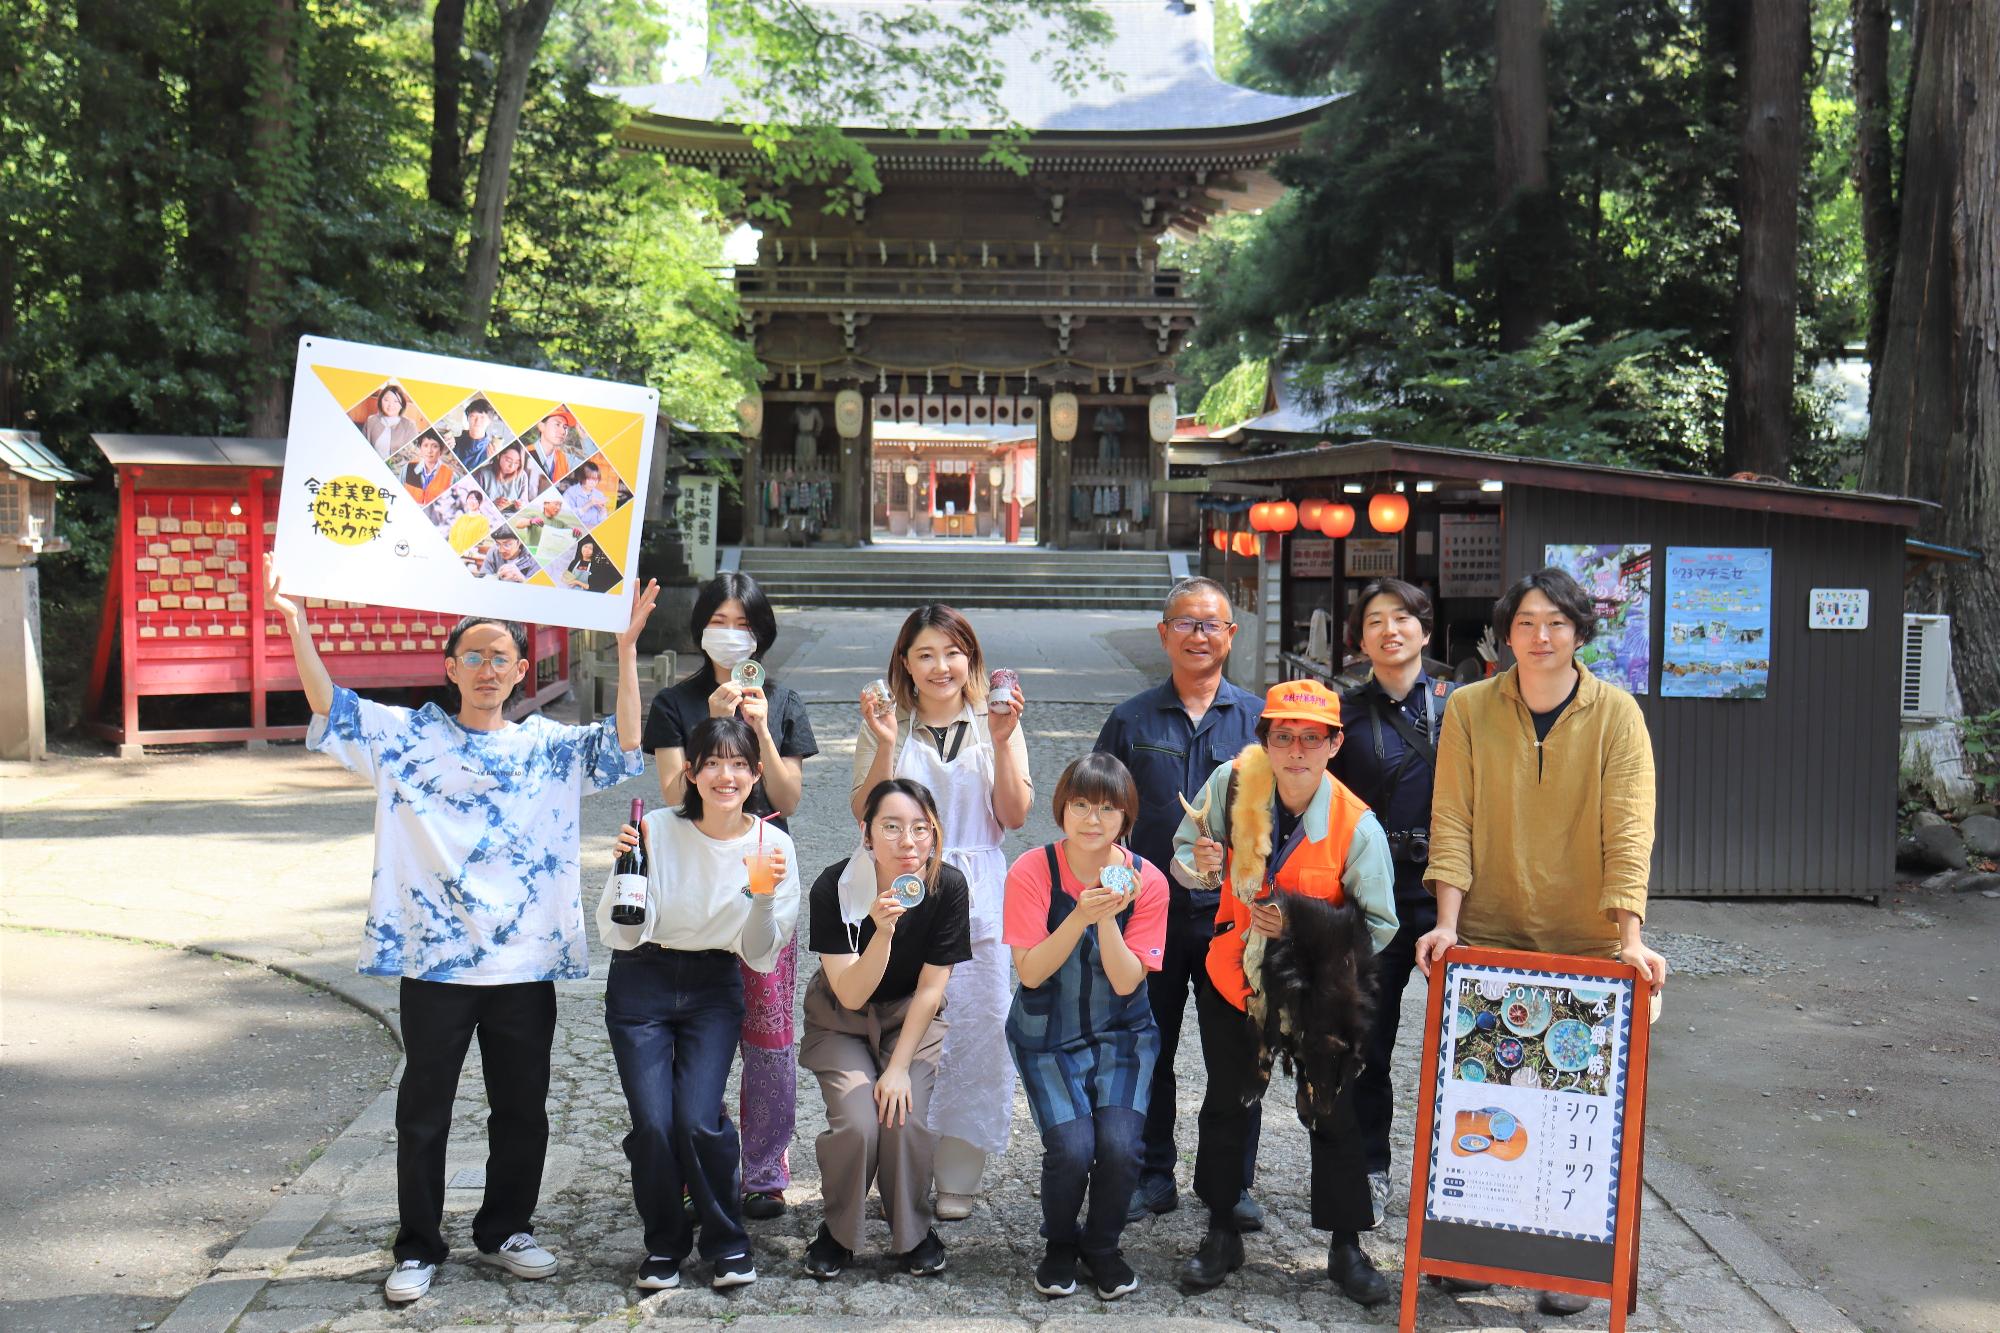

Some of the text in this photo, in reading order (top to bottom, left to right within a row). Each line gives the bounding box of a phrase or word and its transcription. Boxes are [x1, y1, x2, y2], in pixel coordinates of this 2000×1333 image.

[304, 477, 397, 505] 会津美里町
[307, 499, 393, 523] 地域おこし
[311, 519, 382, 541] 協力隊
[1460, 980, 1572, 1005] HONGOYAKI
